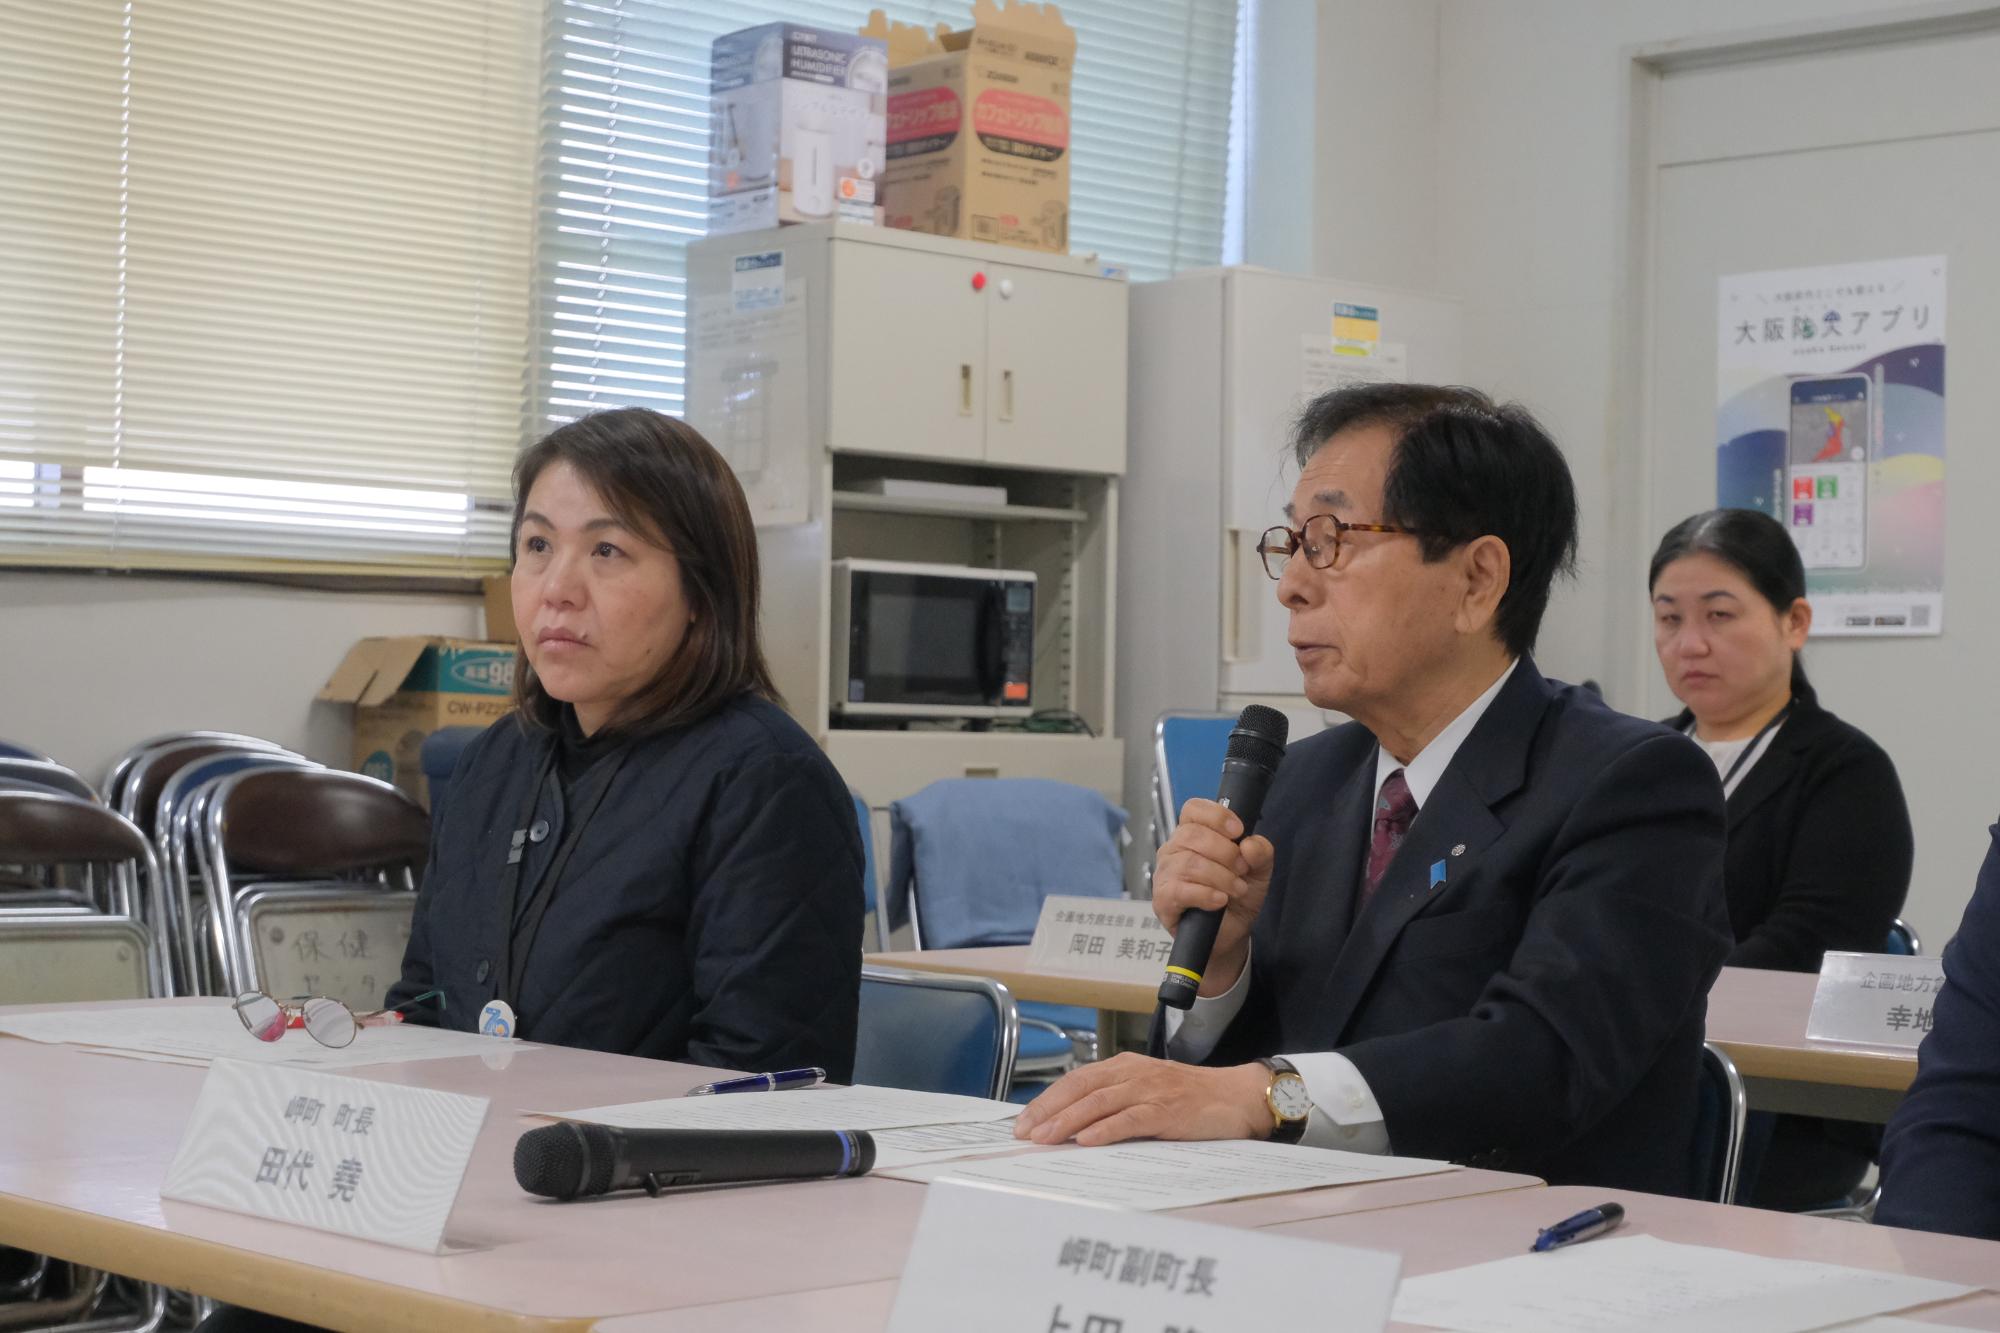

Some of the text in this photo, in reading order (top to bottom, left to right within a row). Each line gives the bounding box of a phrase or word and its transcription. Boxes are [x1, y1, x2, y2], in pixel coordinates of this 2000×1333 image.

[1068, 932, 1172, 962] 岡田 美和子
[1886, 1004, 1934, 1033] 幸地
[284, 1096, 376, 1136] 岬町 町長
[255, 1146, 315, 1191] 田代
[1057, 1236, 1218, 1297] 岬町副町長
